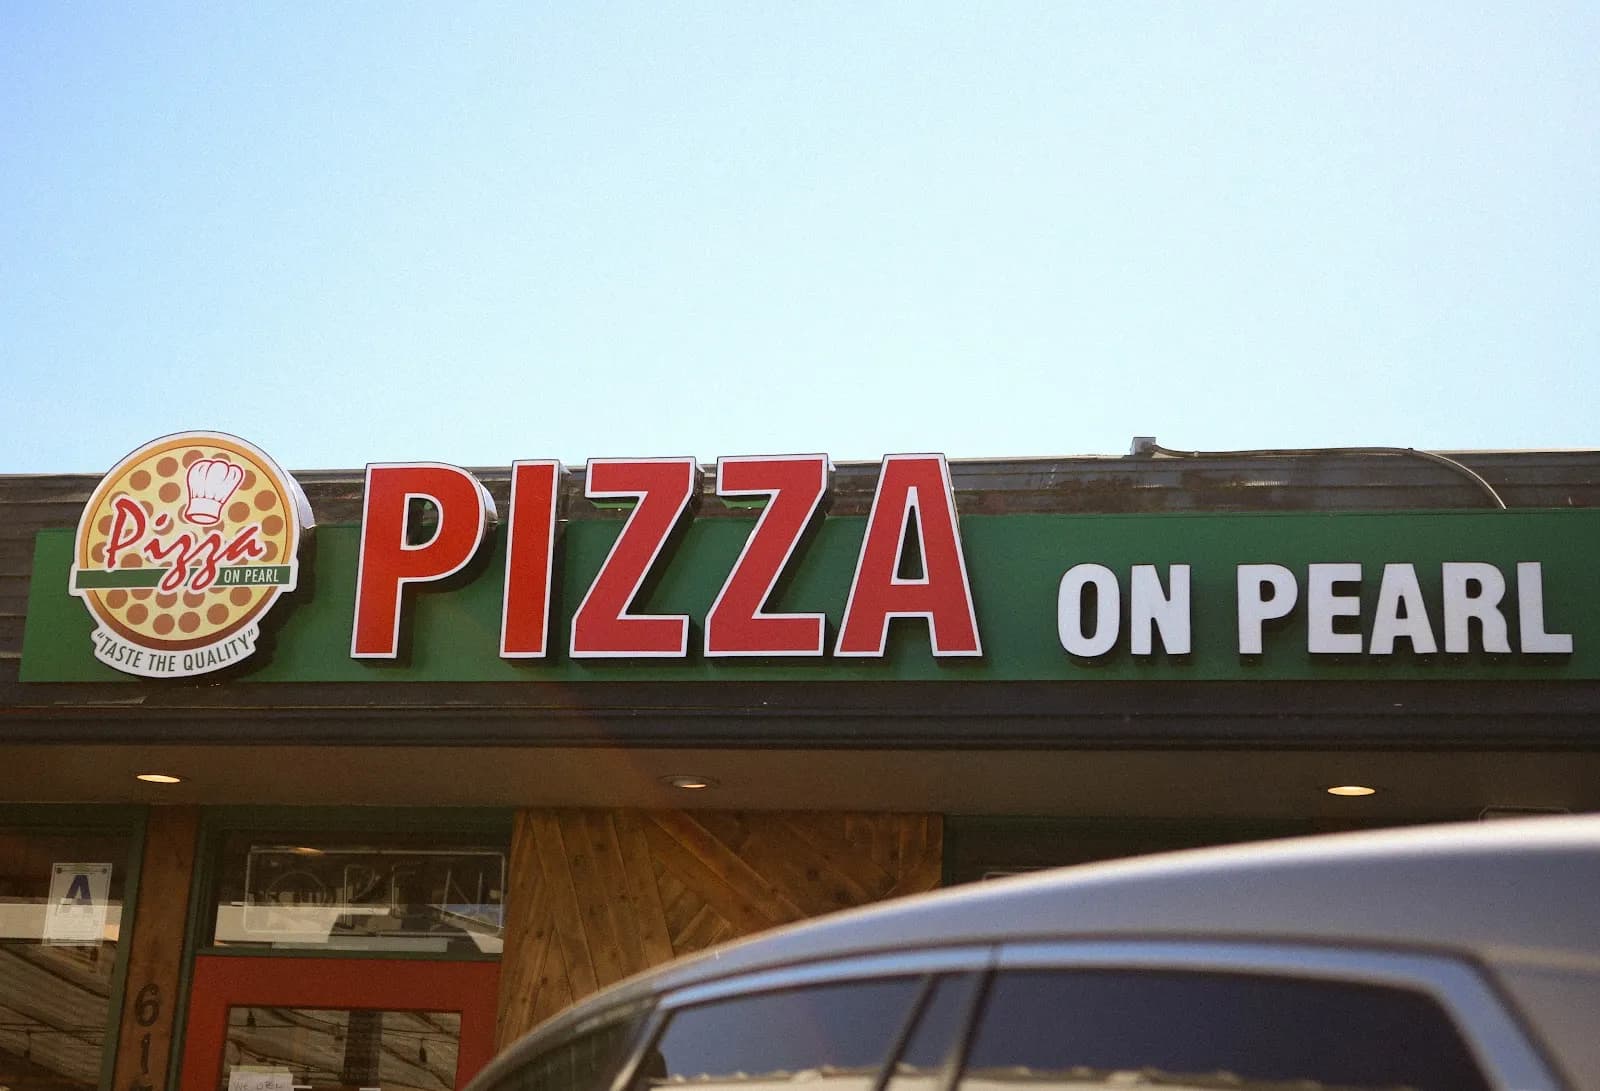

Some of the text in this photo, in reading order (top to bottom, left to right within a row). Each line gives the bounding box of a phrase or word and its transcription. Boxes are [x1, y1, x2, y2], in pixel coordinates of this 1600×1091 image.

[106, 498, 263, 591] Pizza
[350, 453, 1573, 659] PIZZA ON PEARL
[223, 567, 280, 583] ON PEARL
[149, 654, 176, 672] THE
[60, 874, 94, 914] A
